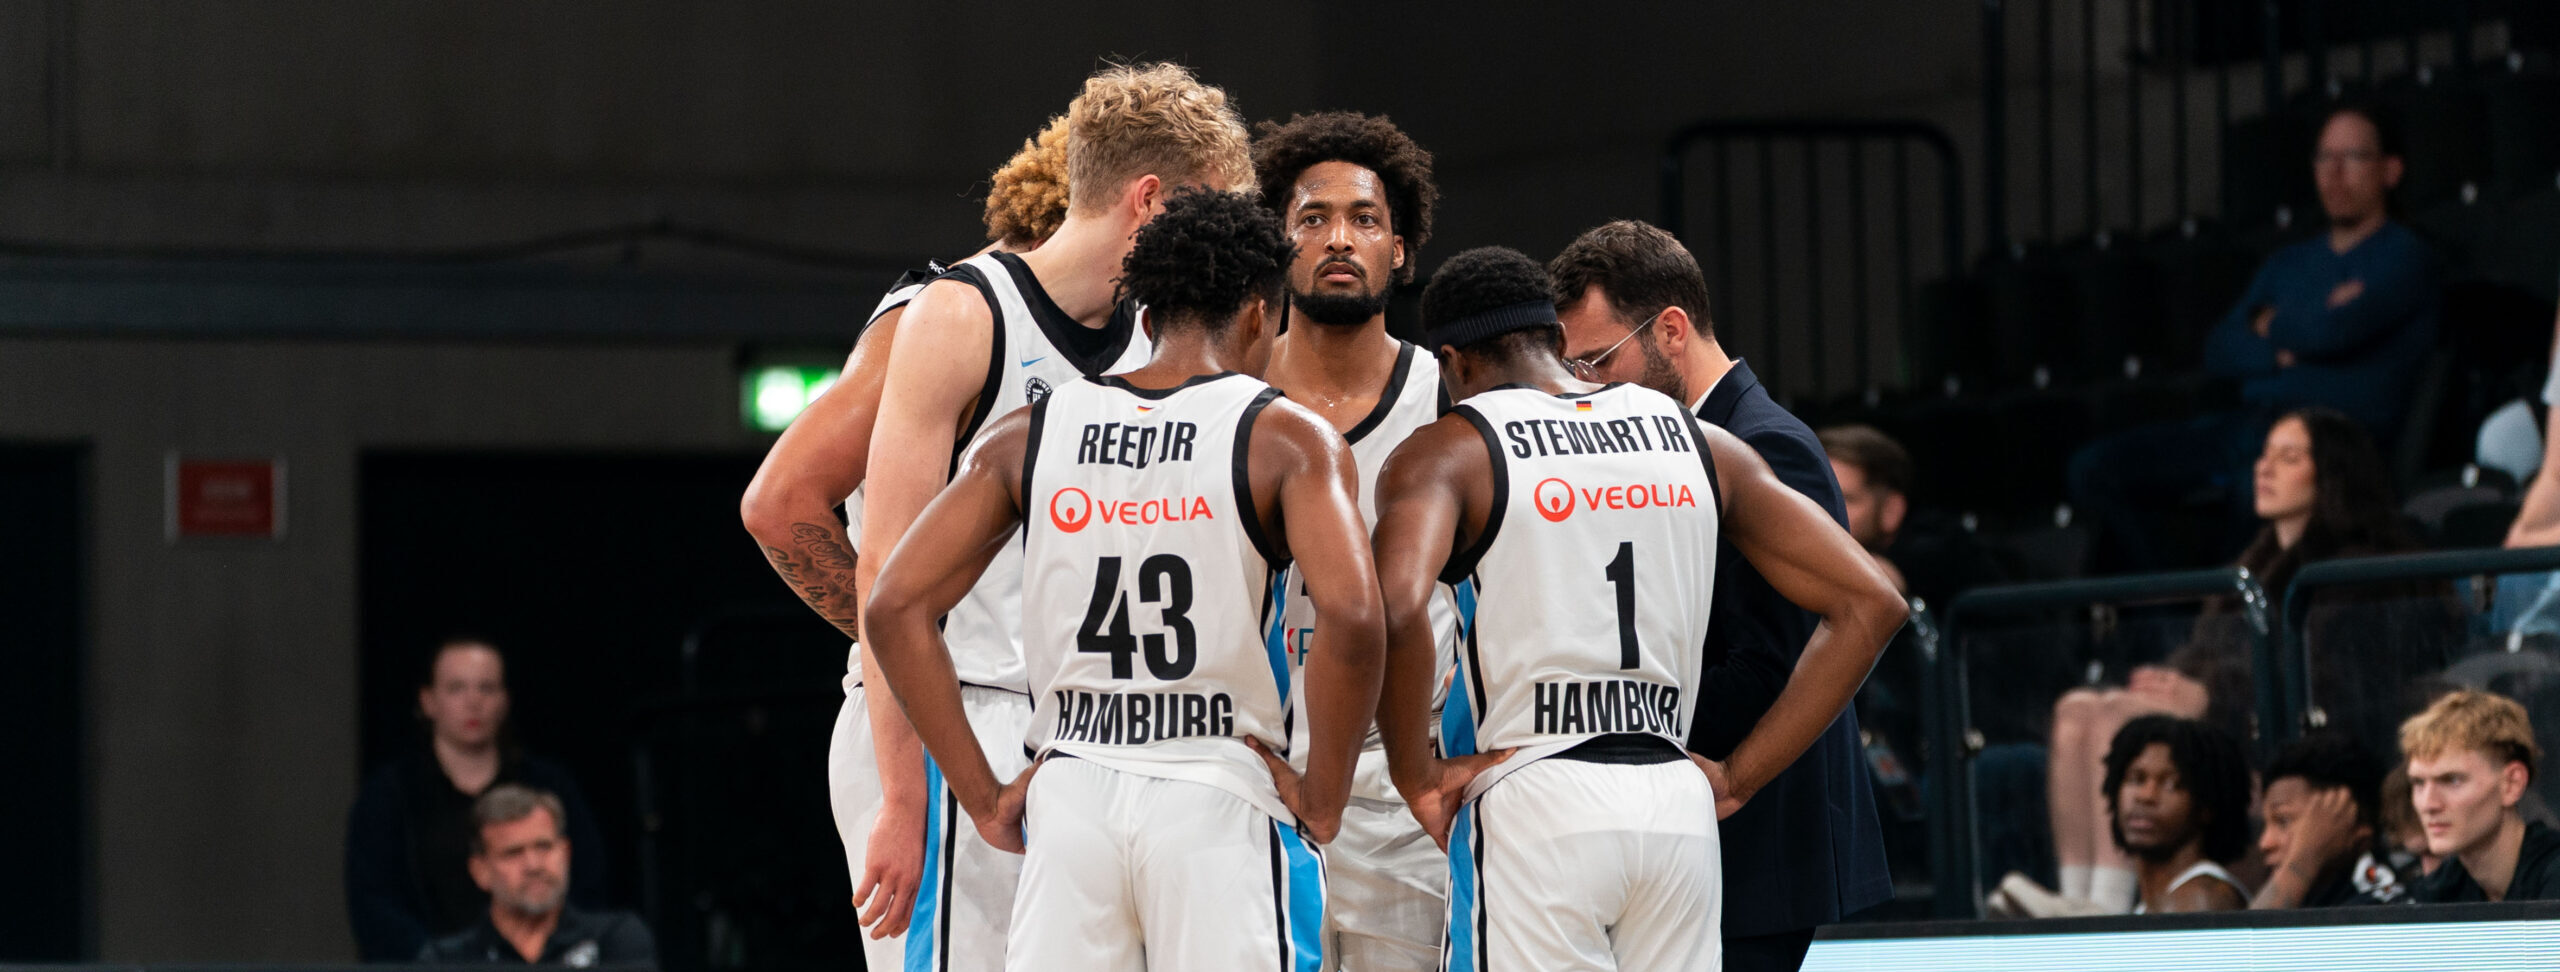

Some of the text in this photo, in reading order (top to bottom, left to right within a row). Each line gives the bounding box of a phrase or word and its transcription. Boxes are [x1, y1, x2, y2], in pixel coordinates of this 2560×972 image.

[1077, 421, 1197, 470] REED JR
[1505, 415, 1690, 459] STEWART JR
[1097, 495, 1214, 526] VEOLIA
[1582, 483, 1696, 512] VEOLIA
[1076, 553, 1197, 681] 43
[1605, 541, 1641, 671] 1
[1054, 689, 1234, 745] HAMBURG
